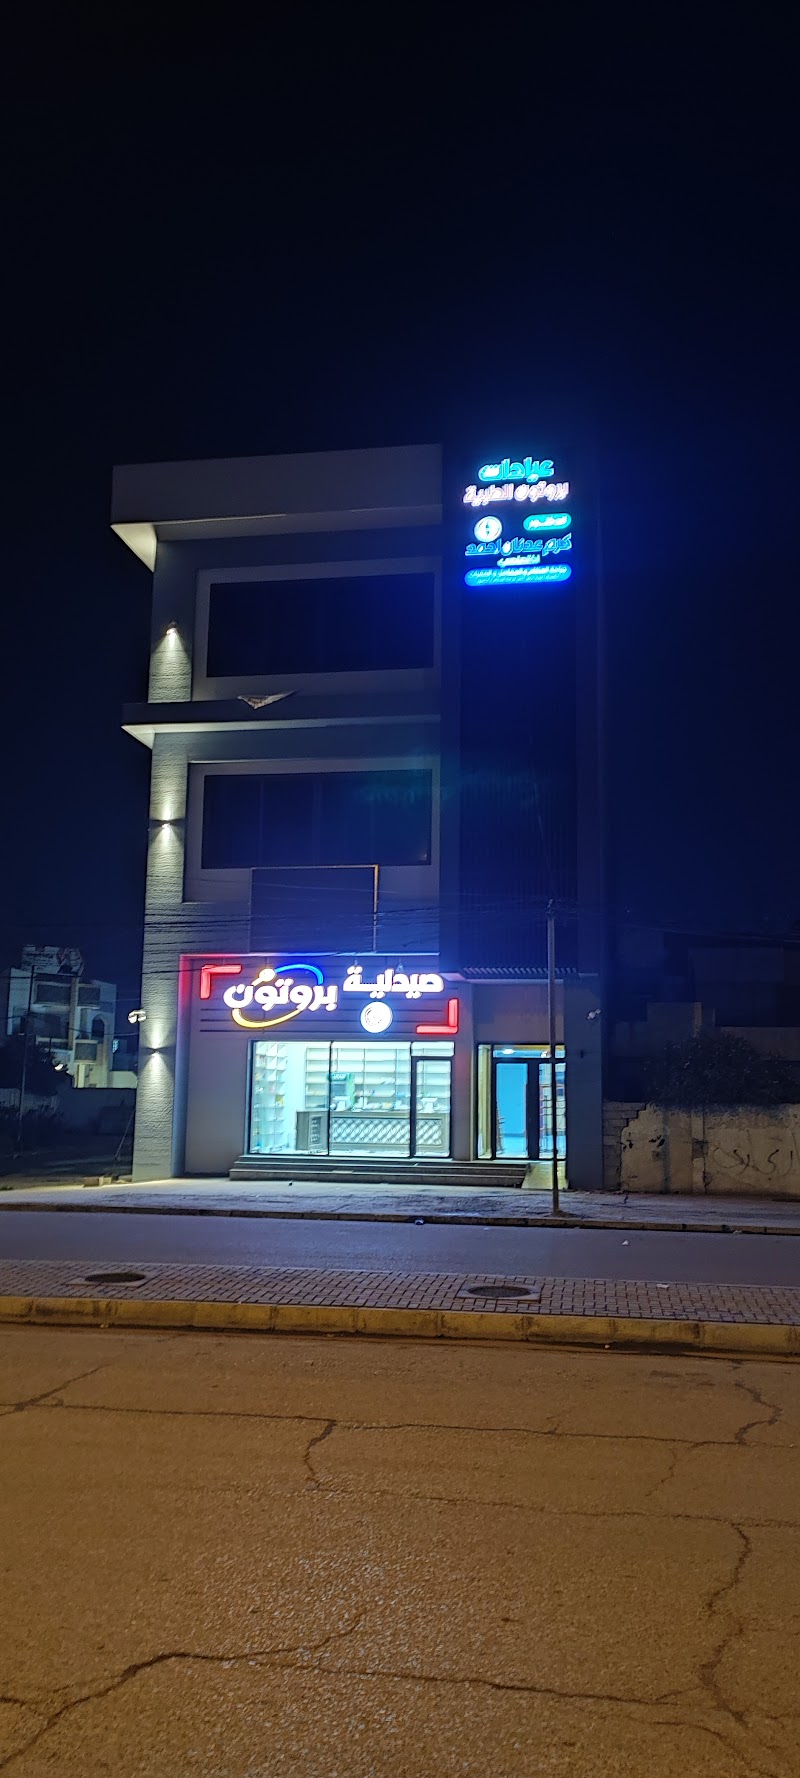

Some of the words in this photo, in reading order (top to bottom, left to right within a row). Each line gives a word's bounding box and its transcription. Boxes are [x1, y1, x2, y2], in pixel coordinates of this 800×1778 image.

[478, 457, 554, 482] عيادات
[463, 483, 514, 506] الطبية
[515, 481, 570, 502] بروتون
[465, 538, 502, 556] احمد
[501, 537, 543, 557] عدنان
[542, 533, 572, 556] كرم
[343, 965, 445, 999] صيدلية
[223, 977, 338, 1012] بروتون
